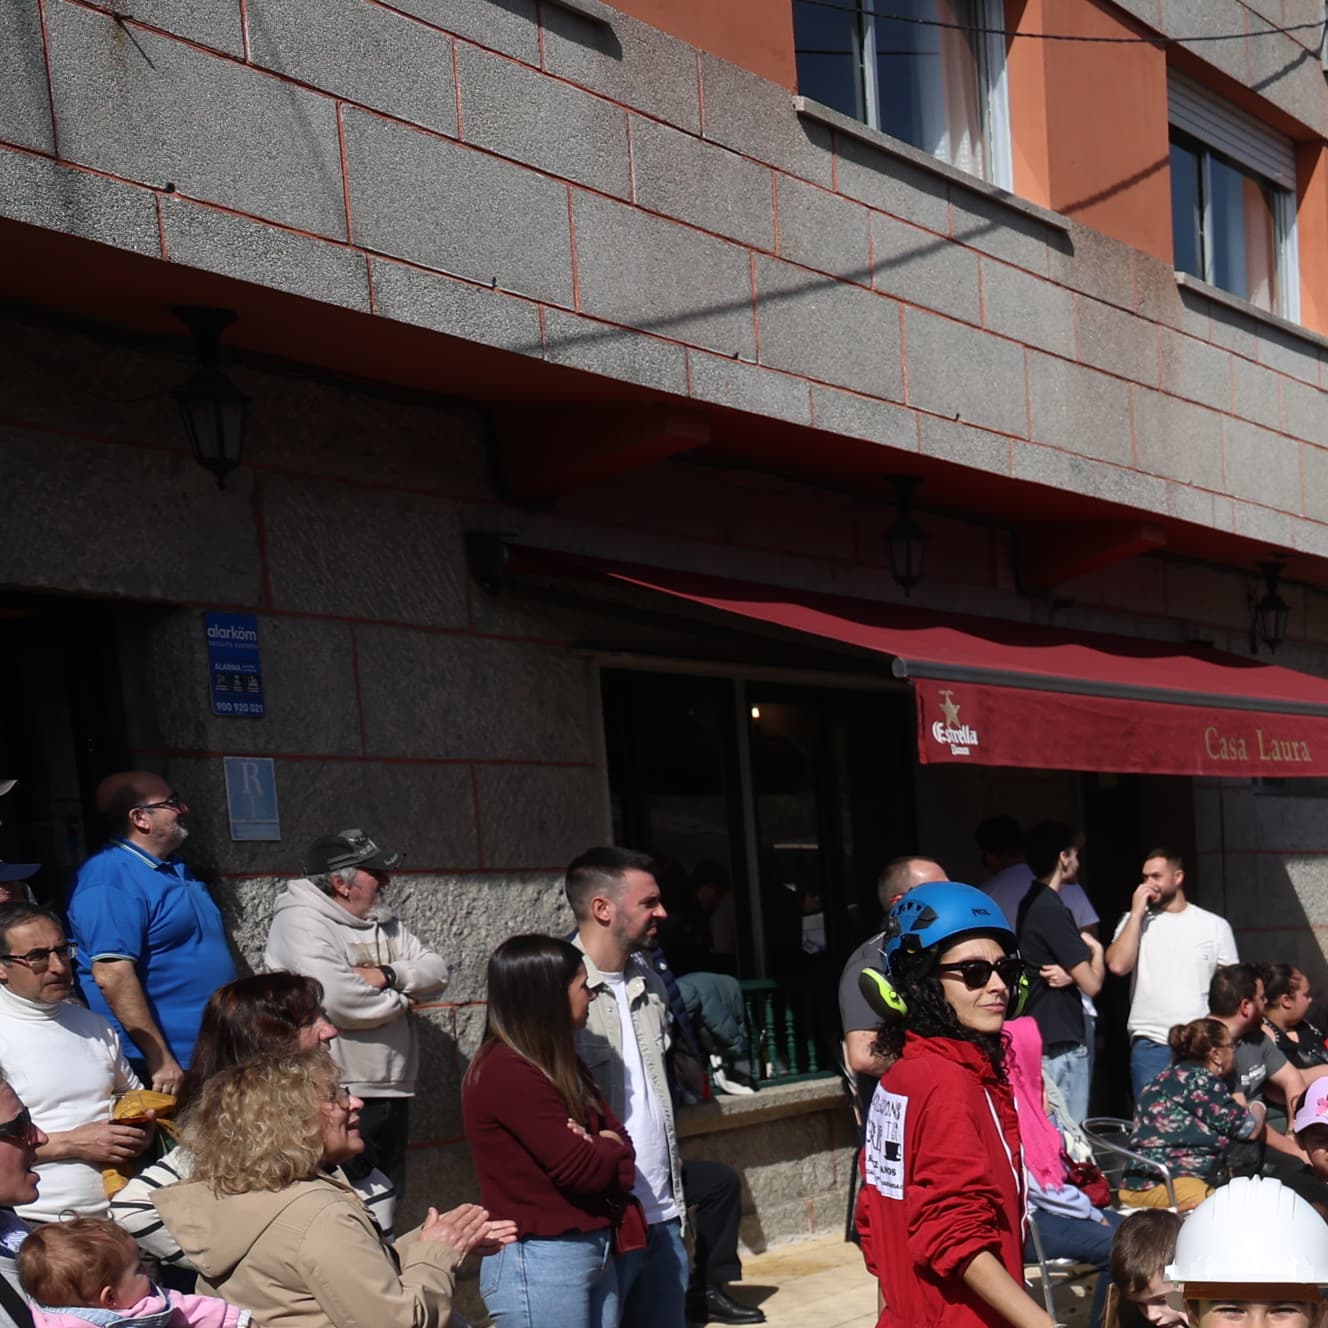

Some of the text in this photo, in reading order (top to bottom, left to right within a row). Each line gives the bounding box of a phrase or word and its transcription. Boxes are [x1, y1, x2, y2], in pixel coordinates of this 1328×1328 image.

[215, 701, 264, 713] 900 920 021
[932, 721, 978, 745] Estrella
[1204, 726, 1312, 762] Casa Laura
